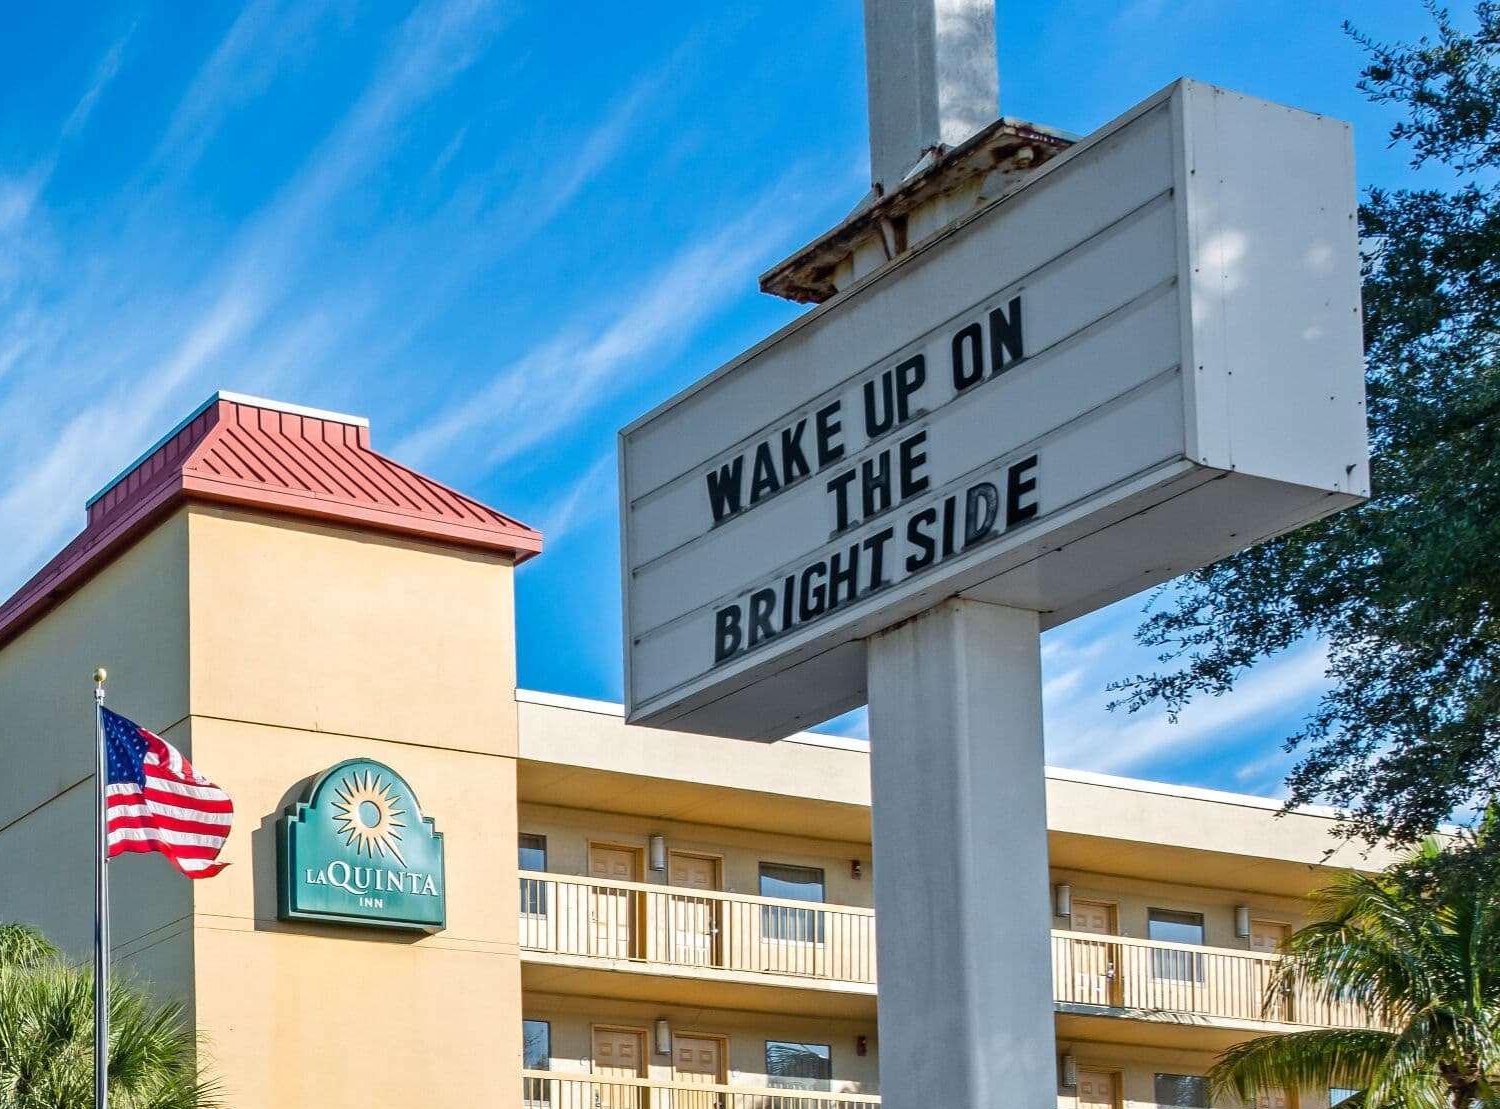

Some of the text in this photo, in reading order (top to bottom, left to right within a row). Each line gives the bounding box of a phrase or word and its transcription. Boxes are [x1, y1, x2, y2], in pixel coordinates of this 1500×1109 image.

[706, 296, 1025, 523] WAKE UP ON
[826, 430, 930, 533] THE
[327, 860, 440, 896] QUINTA
[359, 896, 384, 909] INN
